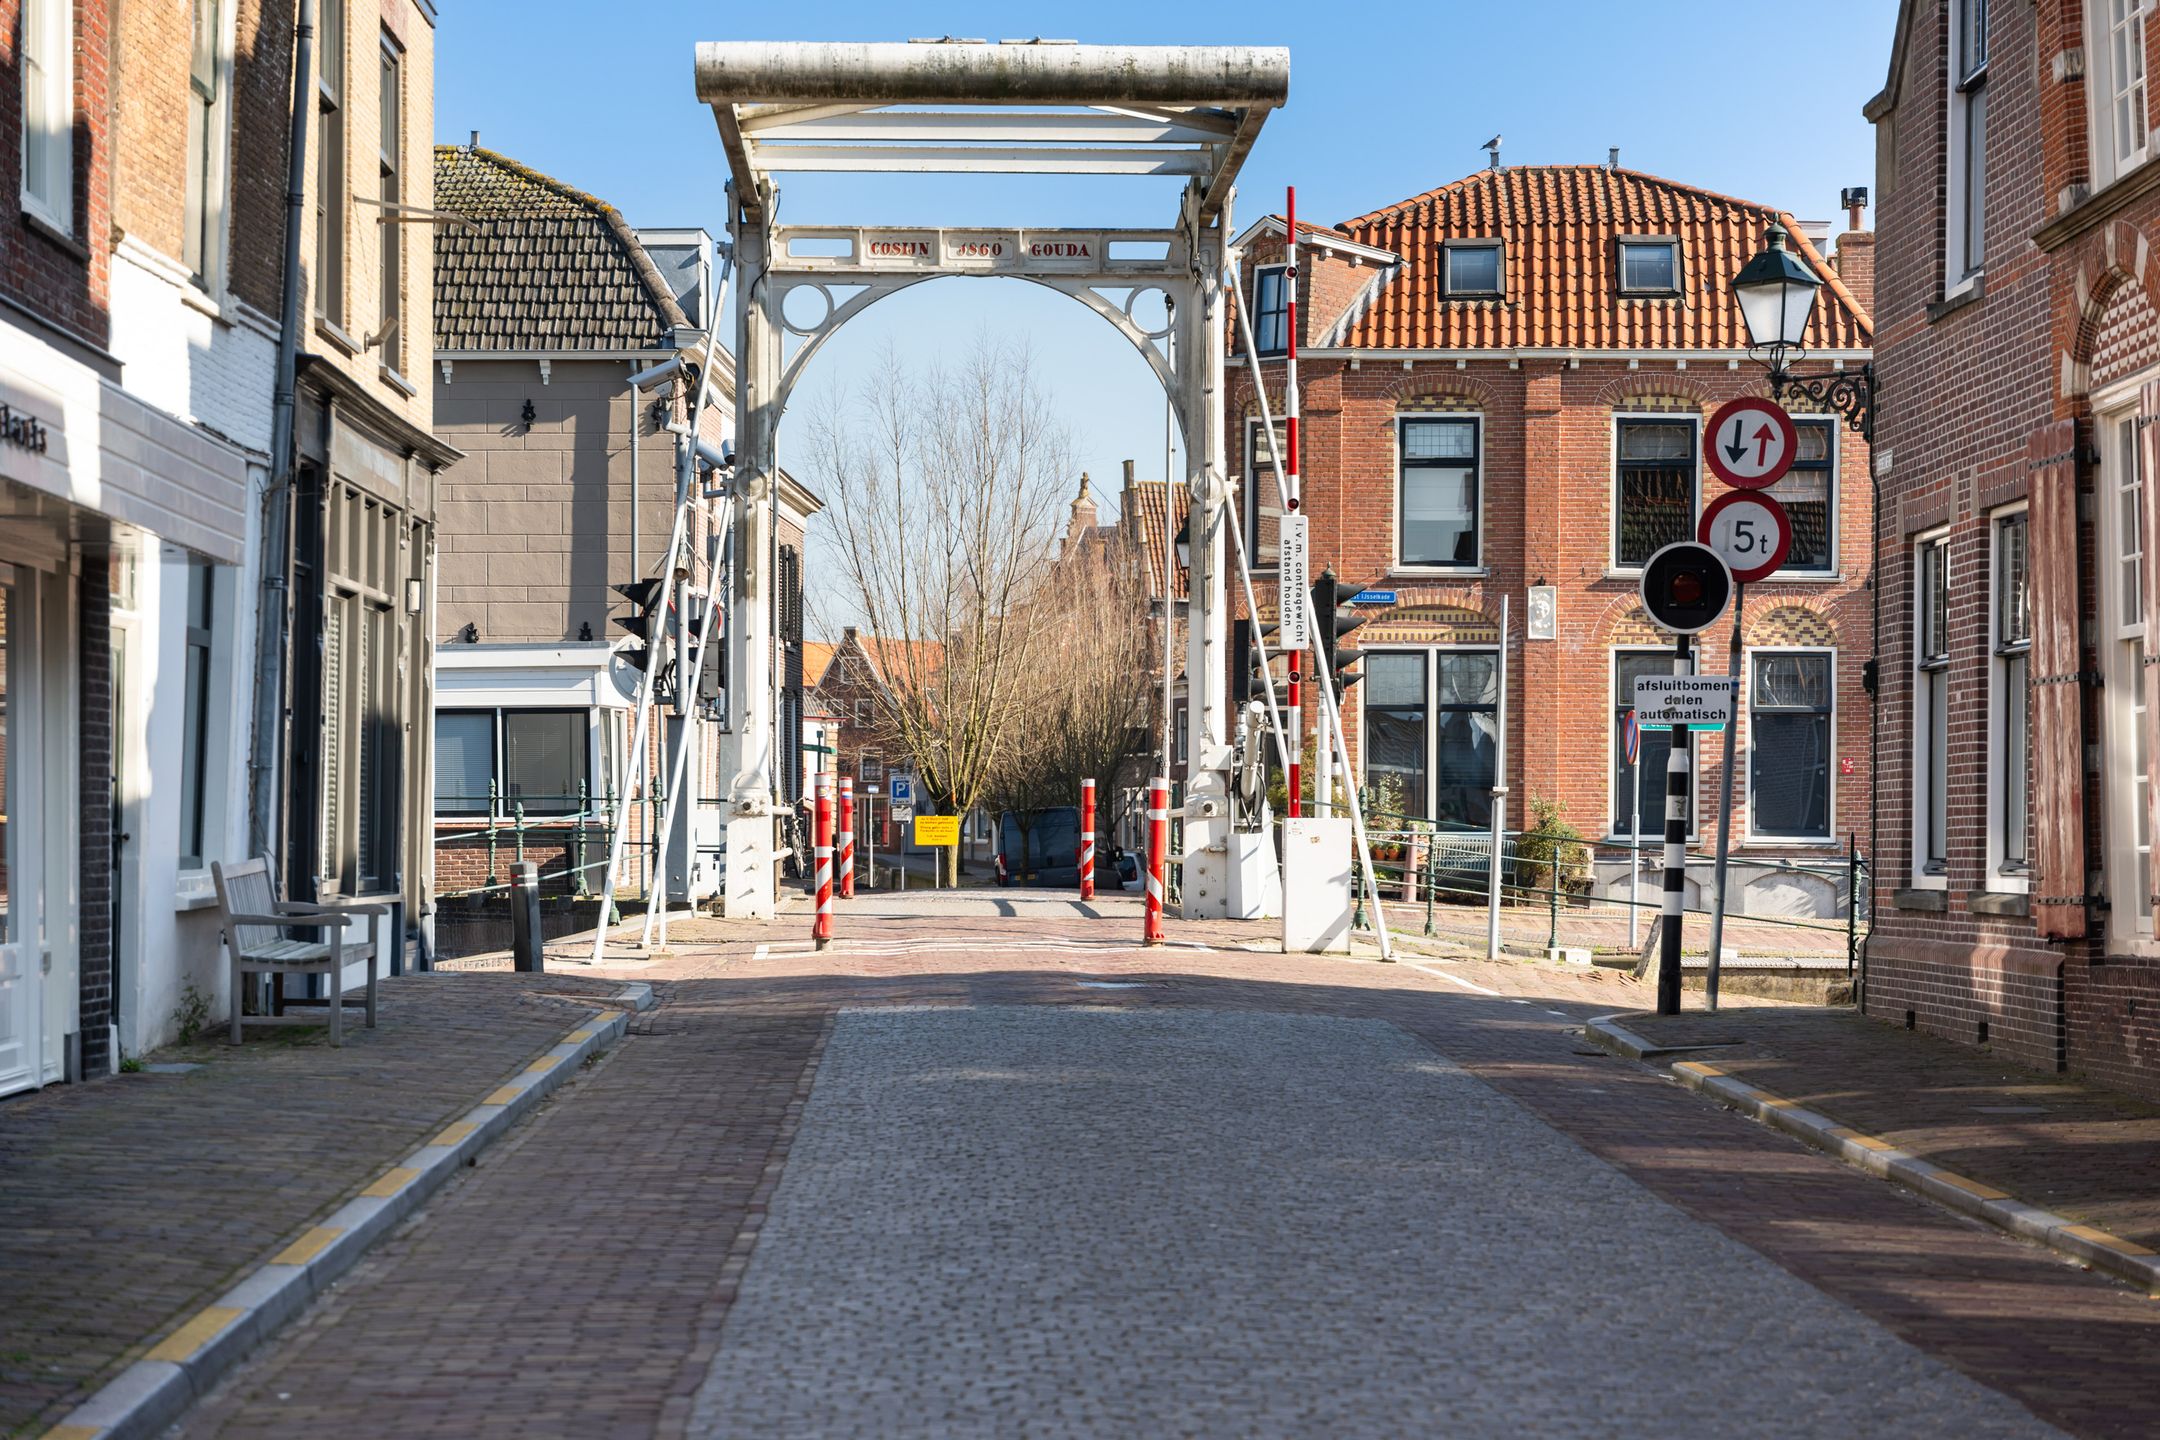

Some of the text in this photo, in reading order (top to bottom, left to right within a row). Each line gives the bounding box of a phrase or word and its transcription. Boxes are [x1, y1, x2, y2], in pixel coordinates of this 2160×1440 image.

[871, 241, 930, 256] COSIJN
[1031, 243, 1091, 257] GOUDA
[1284, 539, 1293, 626] afstand houden
[1294, 562, 1304, 643] contragewicht
[1637, 680, 1730, 691] afsluitbomen
[1664, 694, 1703, 705] dalen
[1640, 709, 1727, 720] automatisch
[896, 782, 906, 797] P
